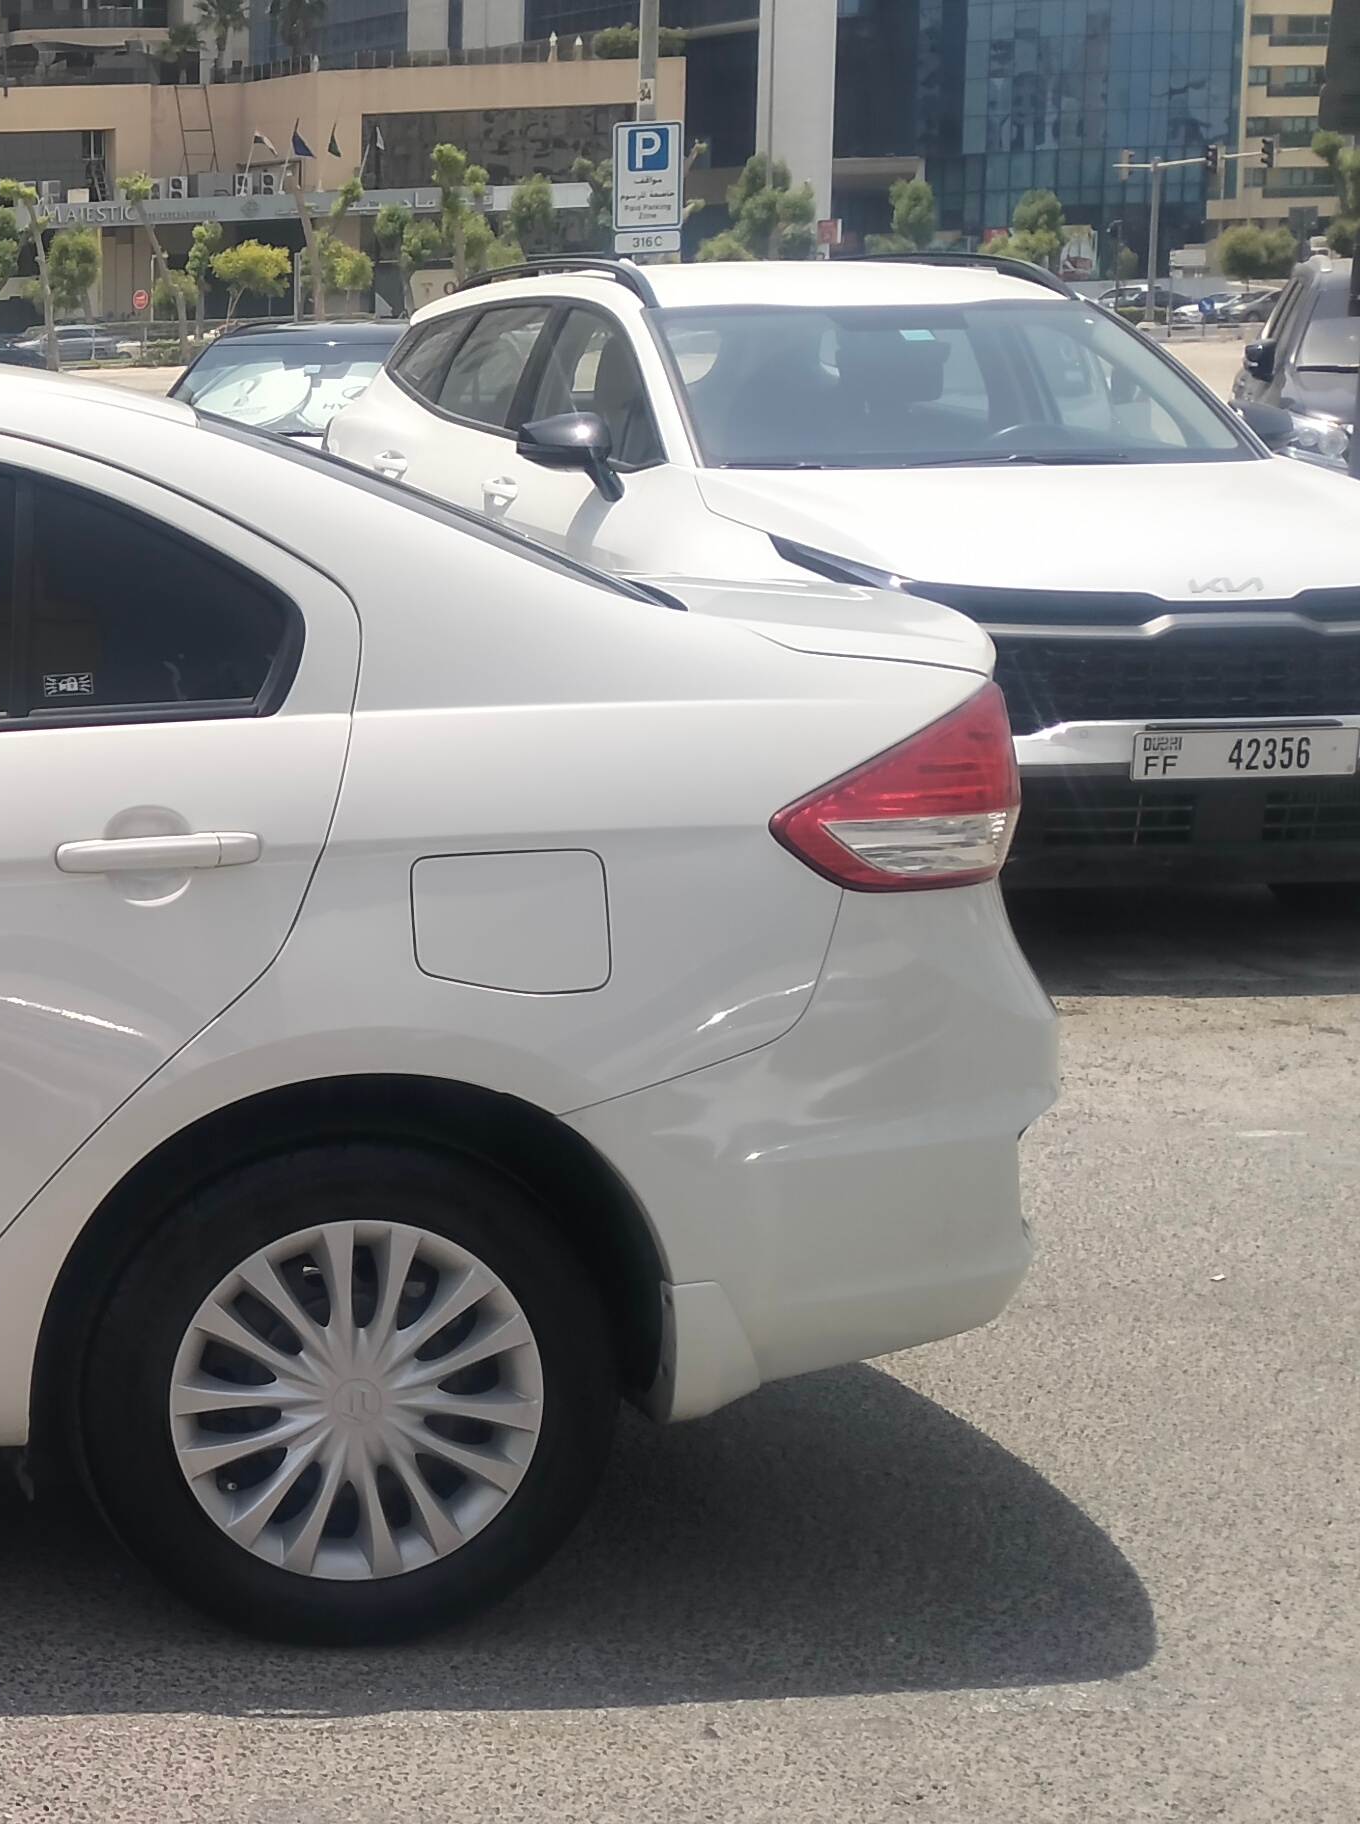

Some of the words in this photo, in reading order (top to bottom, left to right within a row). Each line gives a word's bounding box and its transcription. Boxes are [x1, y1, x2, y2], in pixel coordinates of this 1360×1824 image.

[640, 89, 652, 102] 34
[635, 131, 662, 169] P
[43, 204, 137, 223] MAJESTIC
[1229, 736, 1311, 771] 42356
[1143, 755, 1179, 776] FF
